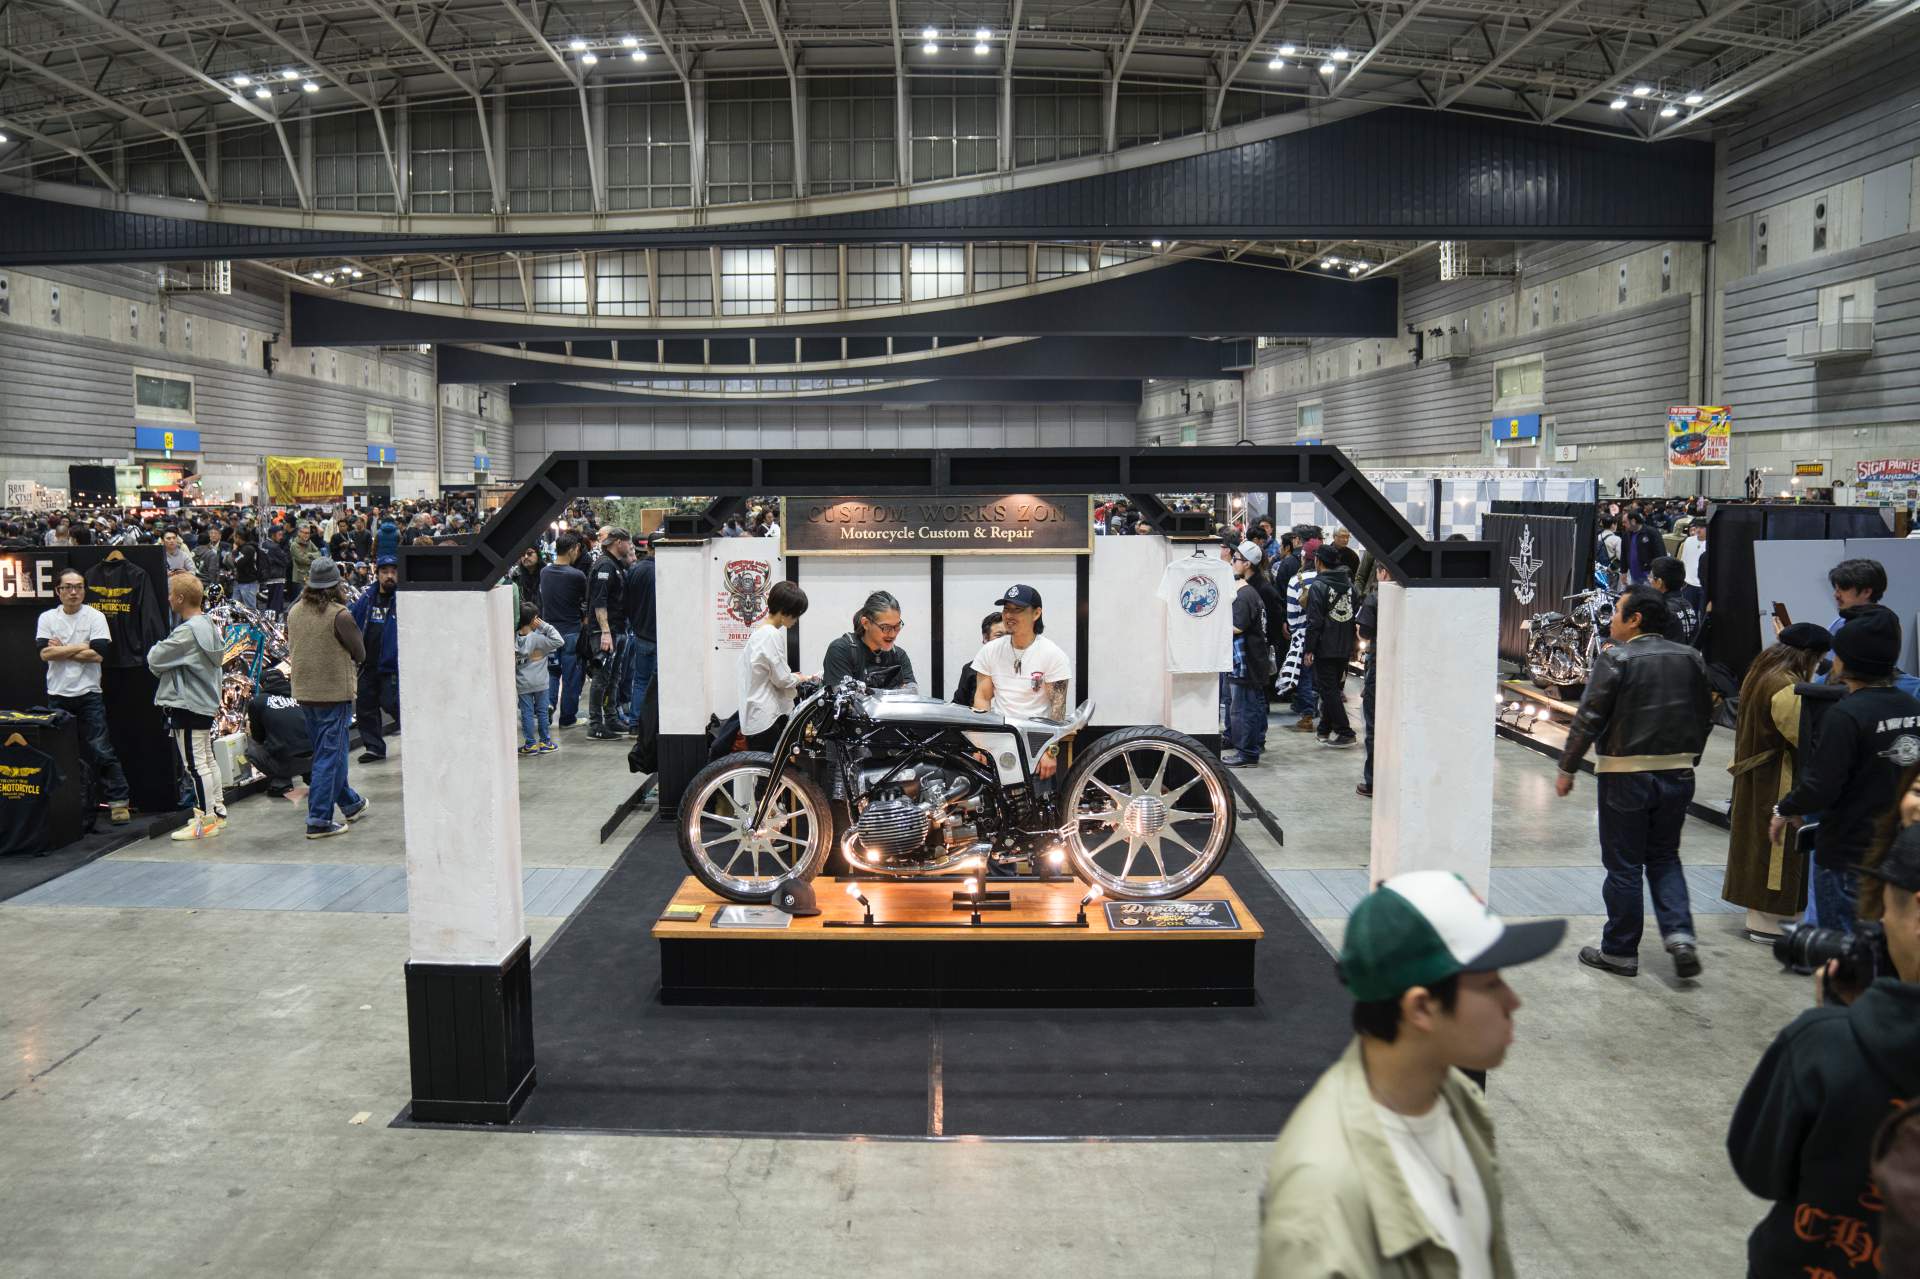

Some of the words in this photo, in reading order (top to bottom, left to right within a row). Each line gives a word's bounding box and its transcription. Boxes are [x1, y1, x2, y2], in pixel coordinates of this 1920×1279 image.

[1859, 460, 1886, 480] SIGN
[297, 468, 342, 494] PANHEAD
[8, 484, 25, 499] BRAT
[808, 505, 908, 524] CUSTOM
[919, 504, 1007, 522] WORKS
[1017, 504, 1067, 523] ZON
[840, 526, 915, 542] Motorcycle
[918, 526, 970, 539] Custom
[974, 527, 987, 538] &
[990, 526, 1034, 542] Repair
[1876, 720, 1886, 733] A
[2, 783, 40, 795] MOTORCYCLE
[1120, 903, 1215, 914] Departed
